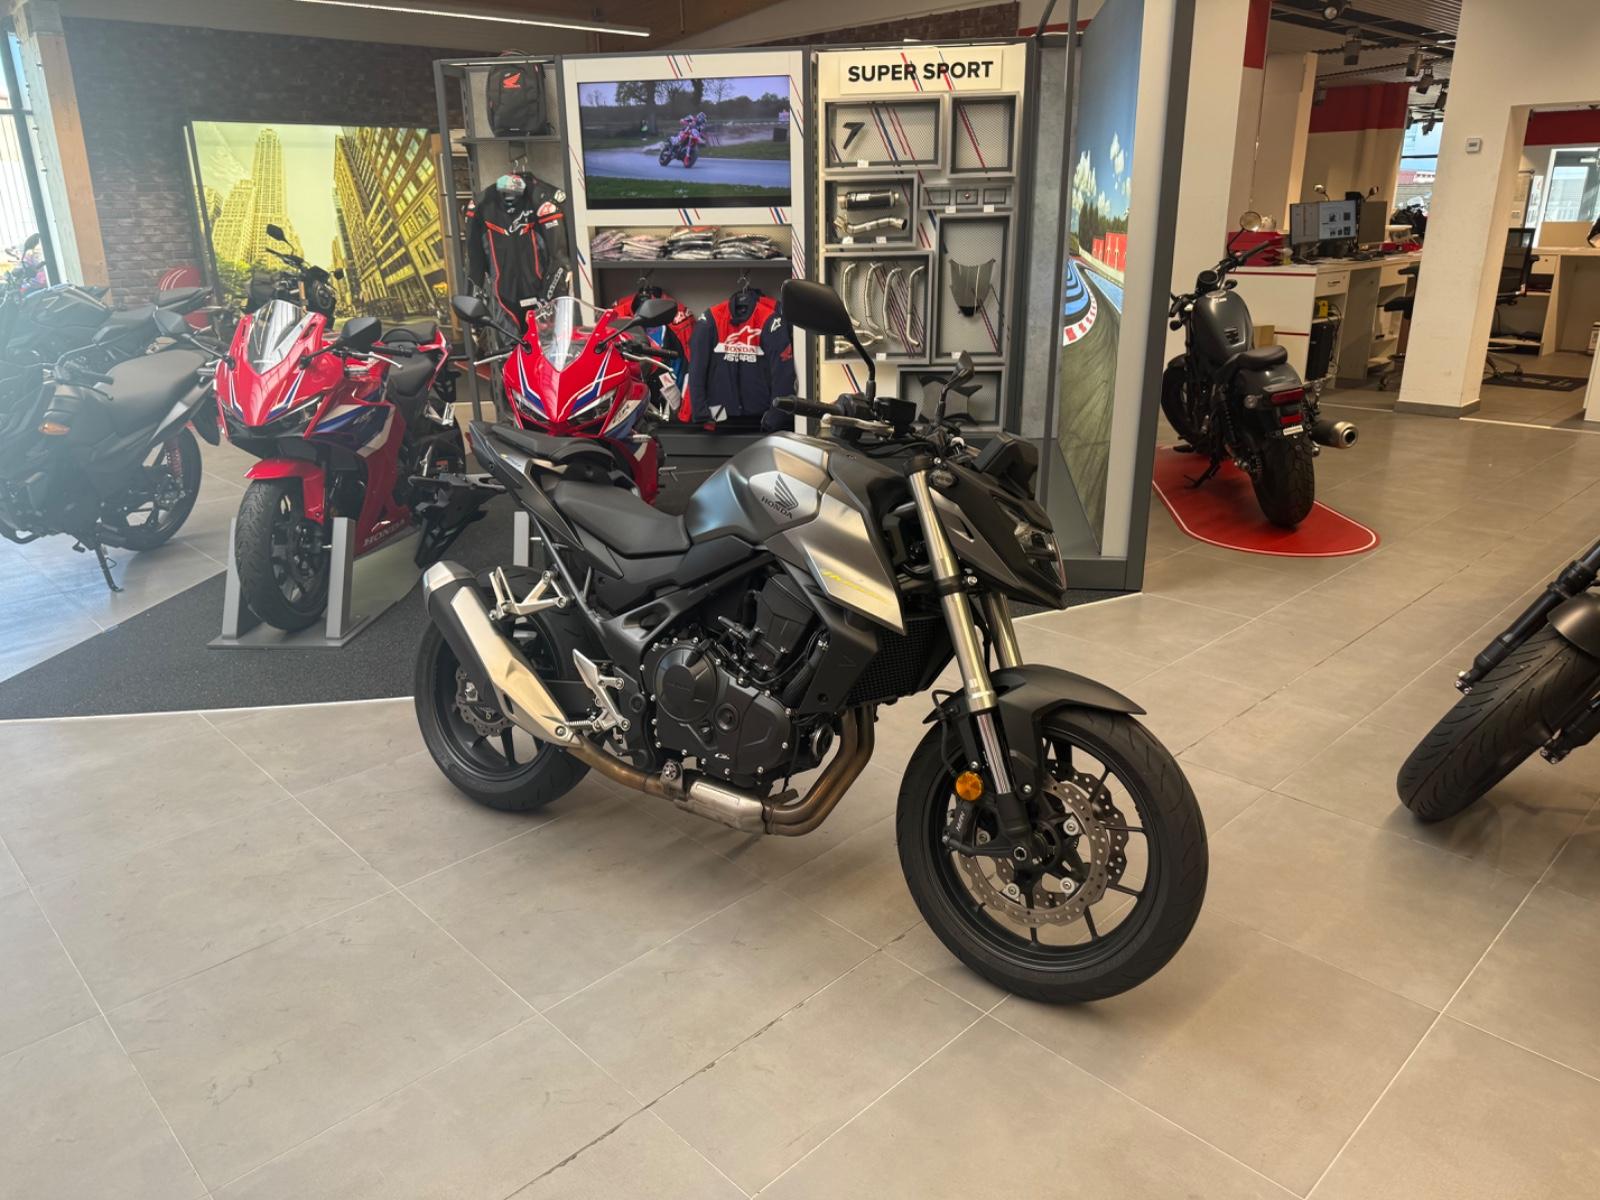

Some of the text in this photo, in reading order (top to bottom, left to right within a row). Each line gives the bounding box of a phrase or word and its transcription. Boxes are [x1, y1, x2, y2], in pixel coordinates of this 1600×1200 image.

[848, 61, 993, 82] SUPER SPORT
[761, 495, 793, 519] HONDA
